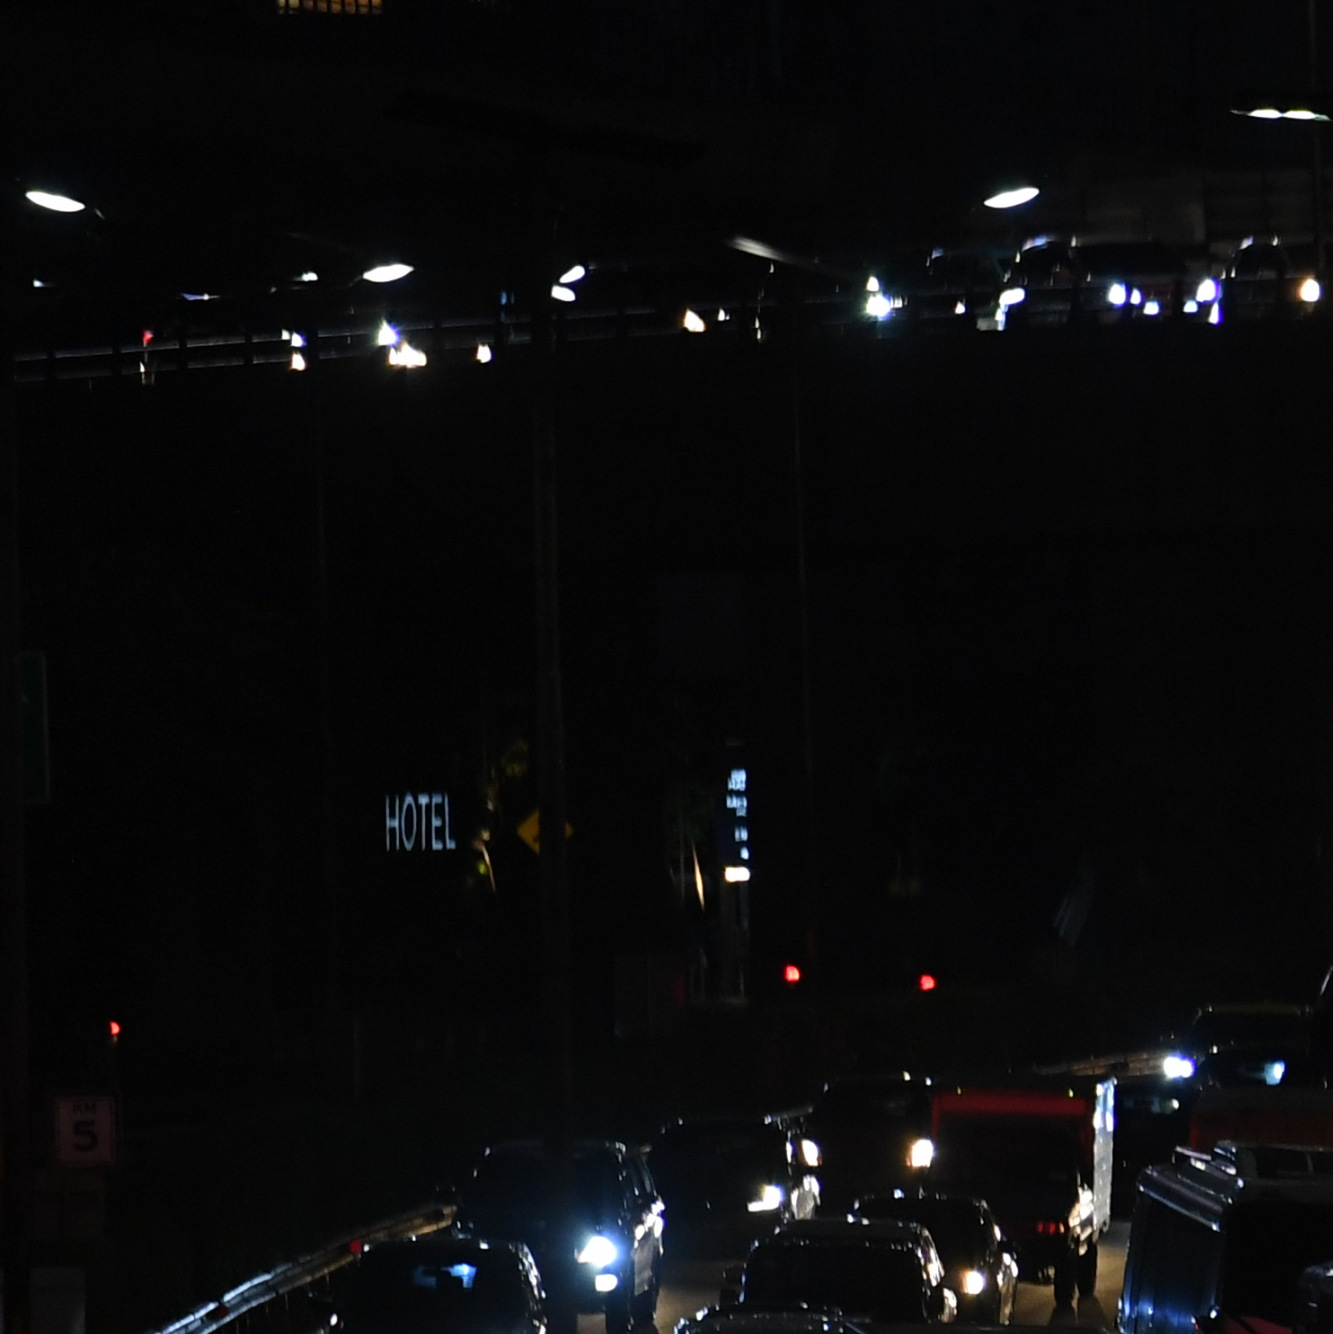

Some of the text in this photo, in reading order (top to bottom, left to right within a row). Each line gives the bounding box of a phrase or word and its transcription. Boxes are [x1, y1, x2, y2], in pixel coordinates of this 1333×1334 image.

[384, 790, 458, 853] HOTEL
[72, 1102, 97, 1113] KM
[73, 1119, 98, 1151] 5
